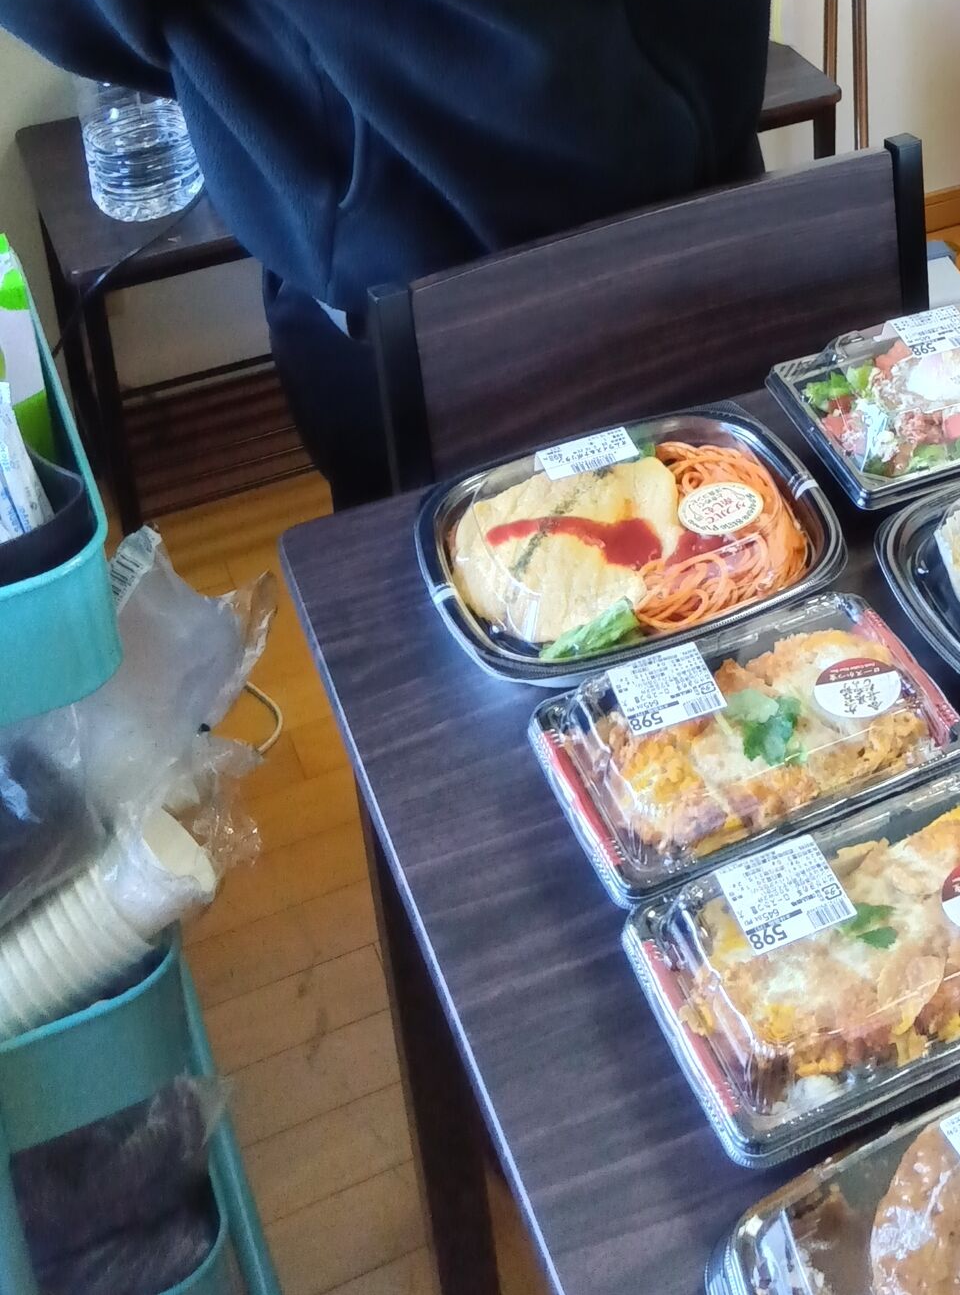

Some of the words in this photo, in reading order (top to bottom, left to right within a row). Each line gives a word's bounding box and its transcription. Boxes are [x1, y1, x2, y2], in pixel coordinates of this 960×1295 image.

[911, 340, 936, 357] 598
[629, 710, 663, 731] 598
[748, 922, 787, 950] 598
